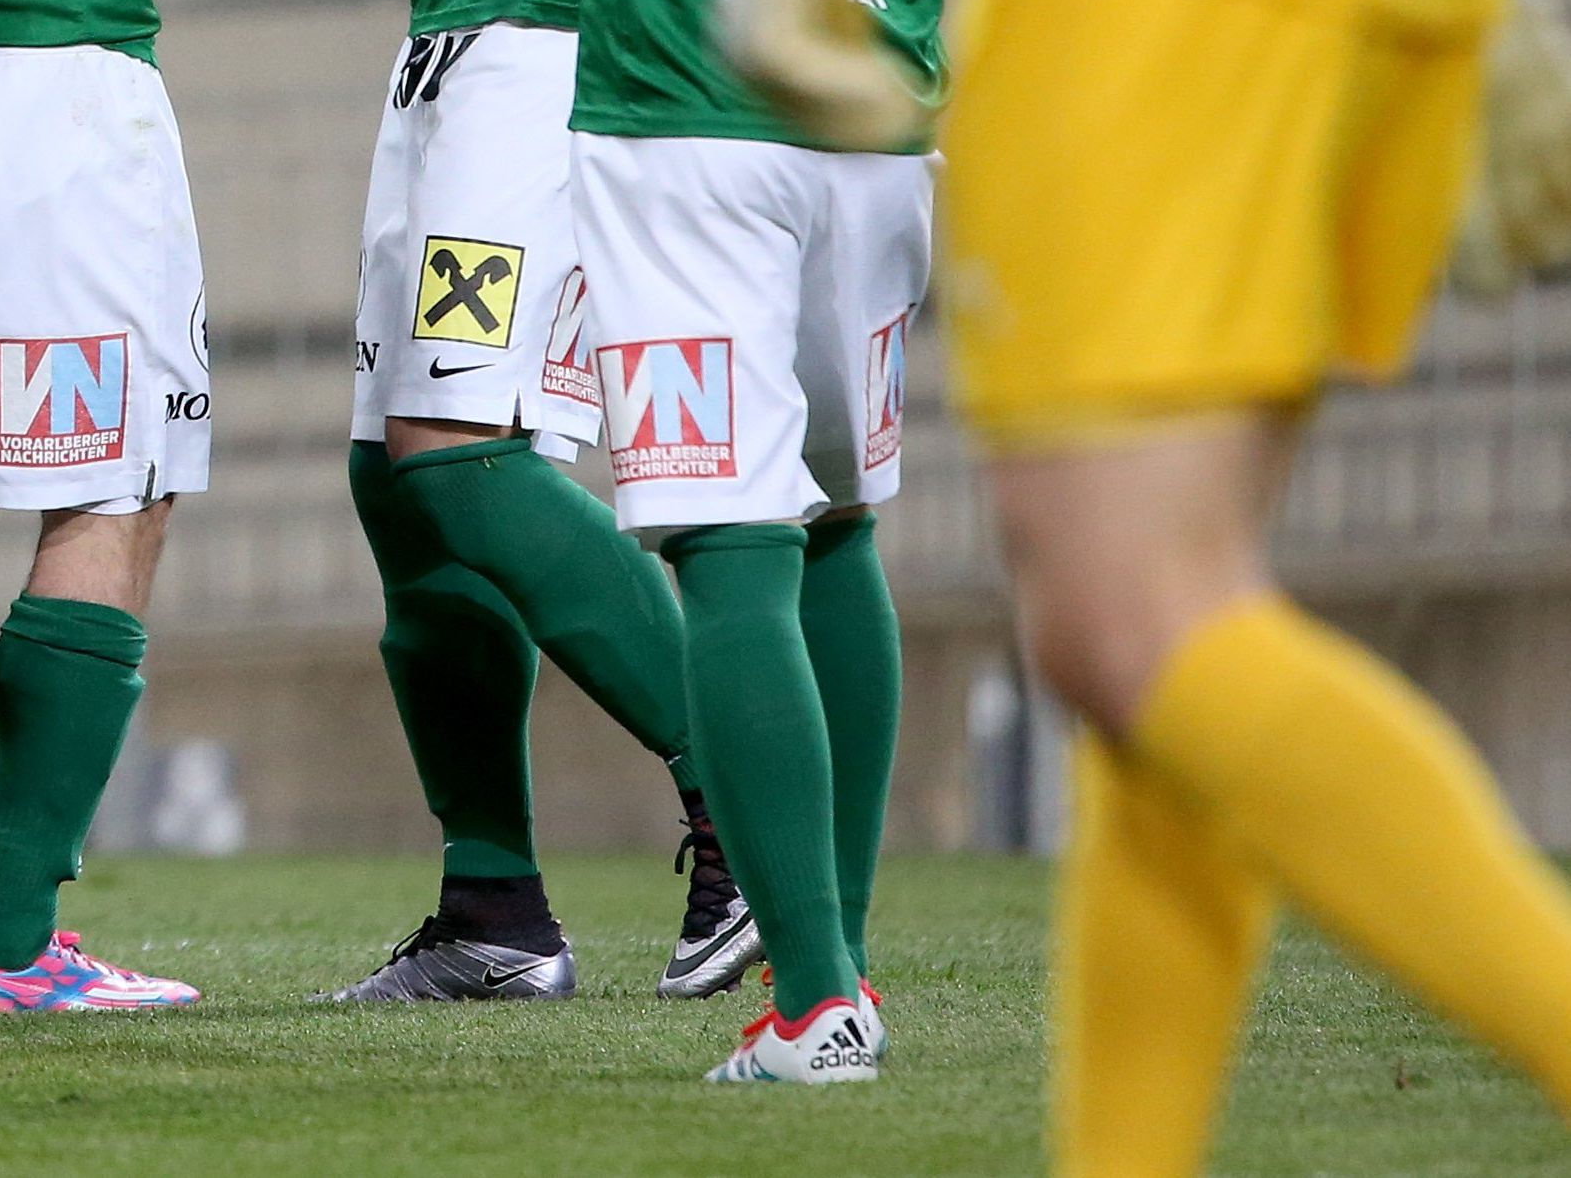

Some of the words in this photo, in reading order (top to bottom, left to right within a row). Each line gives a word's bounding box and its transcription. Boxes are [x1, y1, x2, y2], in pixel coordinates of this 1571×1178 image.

[0, 339, 124, 435] VN
[599, 343, 730, 452] VN
[0, 430, 120, 450] VORARLBERGER
[0, 444, 107, 464] NACHRICHTEN
